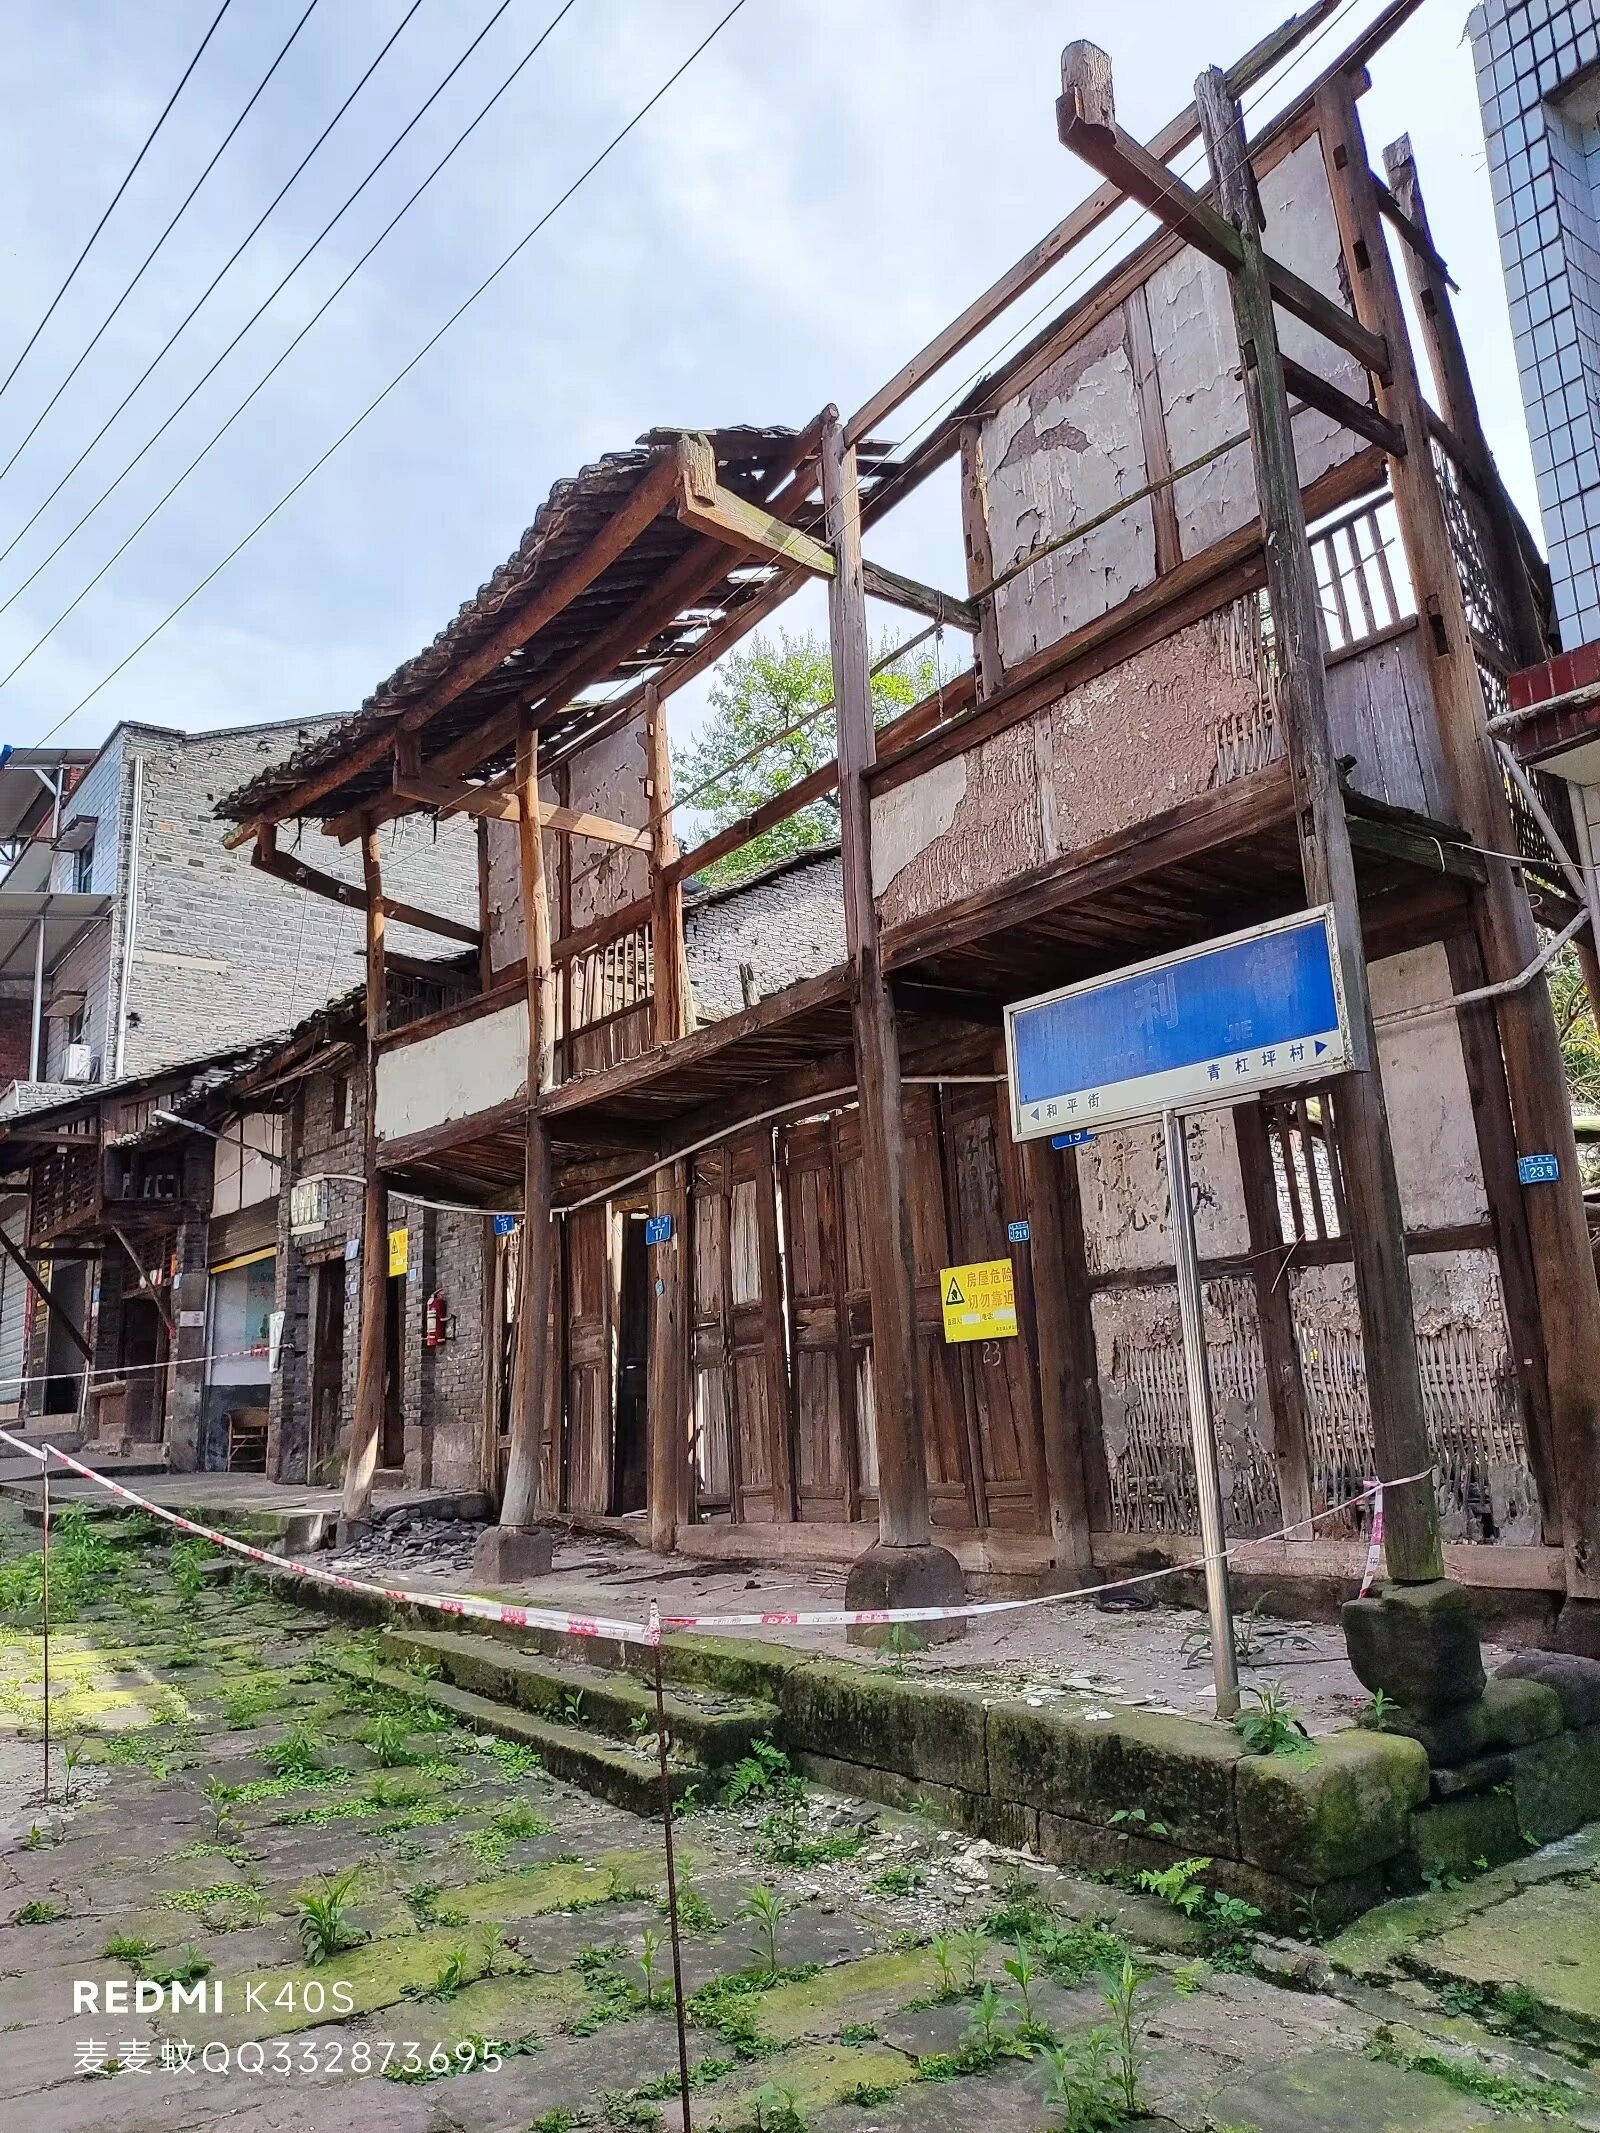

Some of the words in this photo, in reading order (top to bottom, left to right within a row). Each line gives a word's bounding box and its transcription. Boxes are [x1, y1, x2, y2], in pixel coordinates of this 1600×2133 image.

[1207, 1043, 1304, 1081] 青杠坪村
[1046, 1093, 1100, 1119] 和平街
[1529, 1165, 1554, 1178] 23号
[655, 1228, 664, 1241] 17
[966, 1267, 1013, 1288] 房屋危险
[968, 1290, 1015, 1309] 切勿靠近
[982, 1340, 1001, 1367] 23
